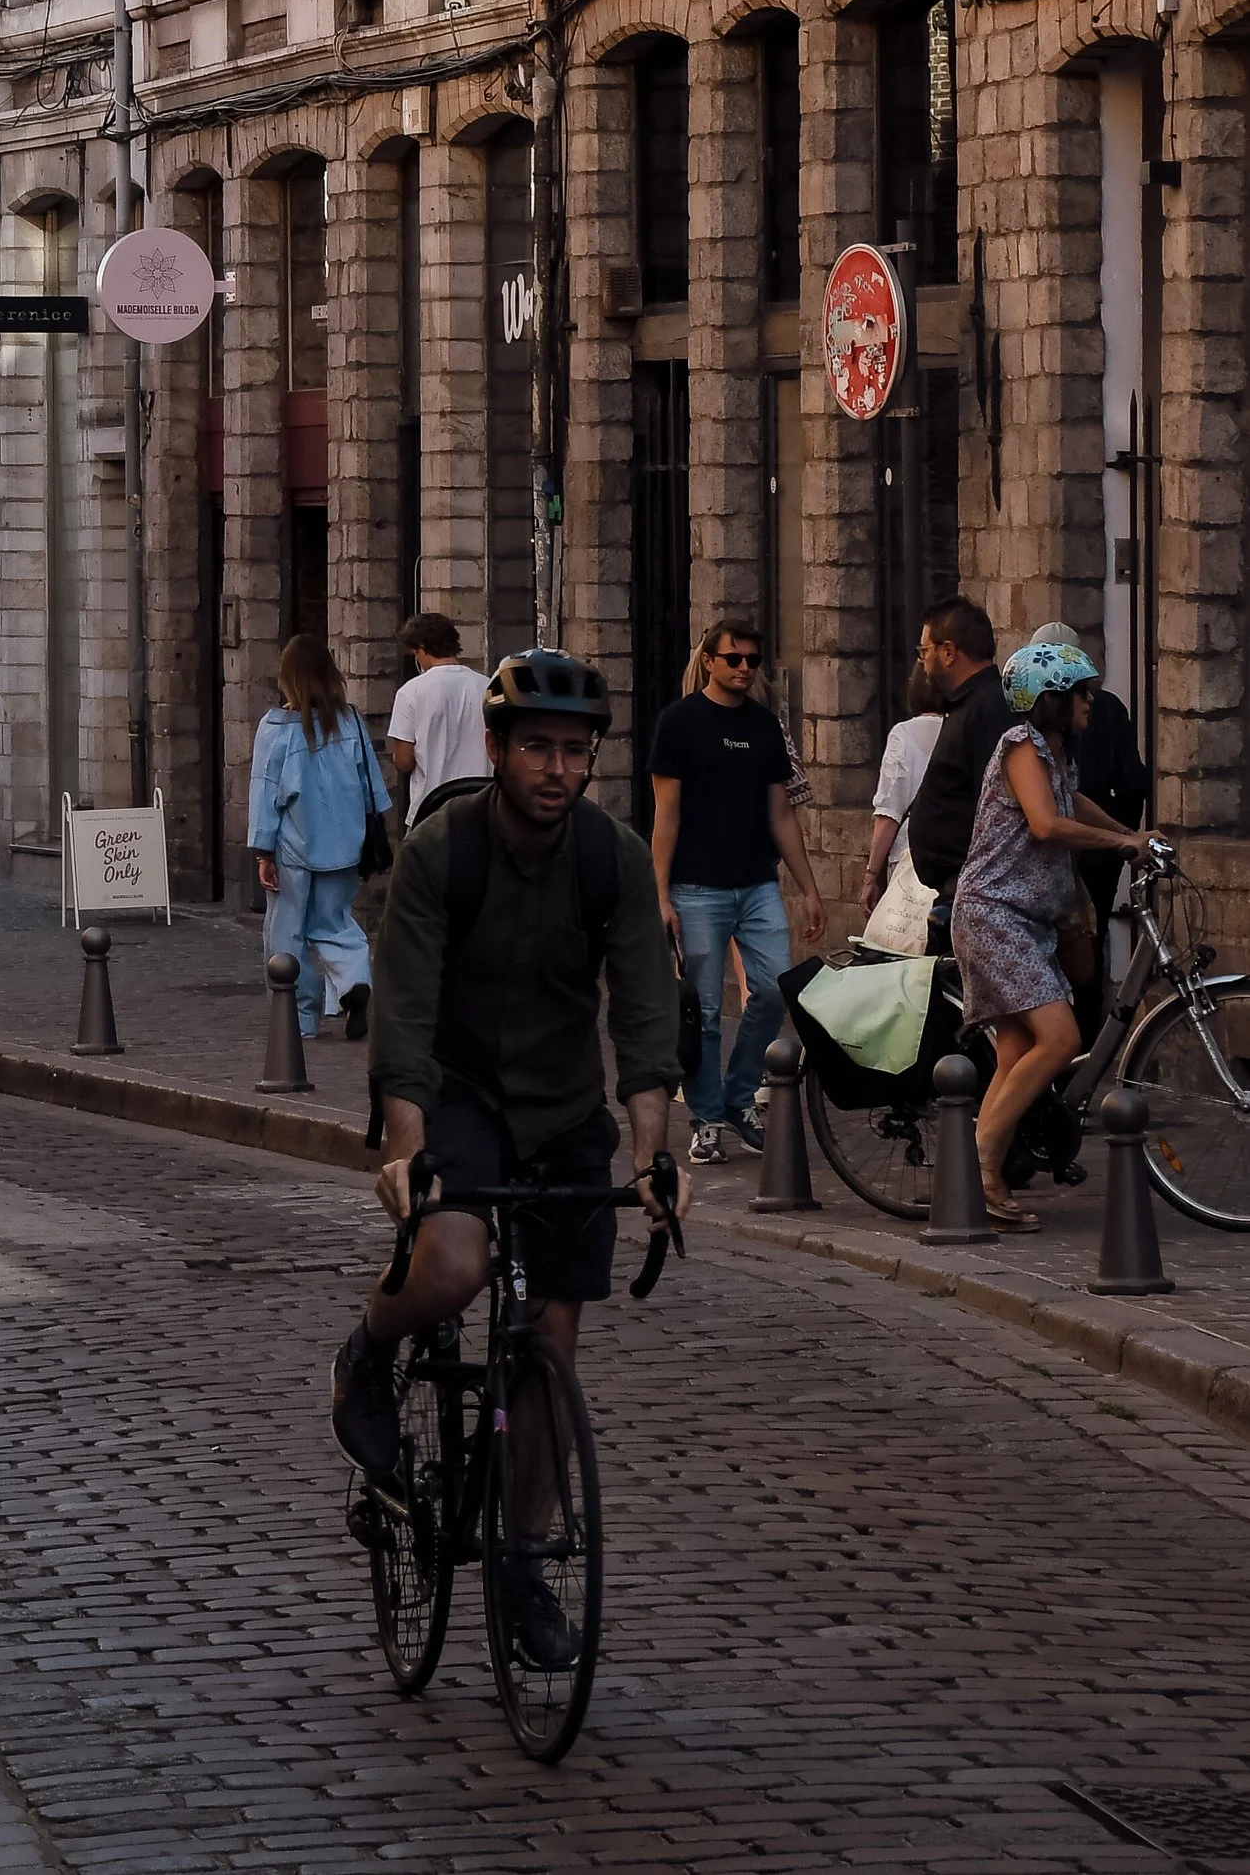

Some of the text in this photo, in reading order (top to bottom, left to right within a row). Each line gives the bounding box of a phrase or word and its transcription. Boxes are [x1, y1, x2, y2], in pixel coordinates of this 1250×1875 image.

[117, 305, 200, 315] MADEMOISELLE BILOBA
[95, 830, 143, 849] Green
[104, 845, 140, 865] Skin
[104, 863, 143, 886] Only
